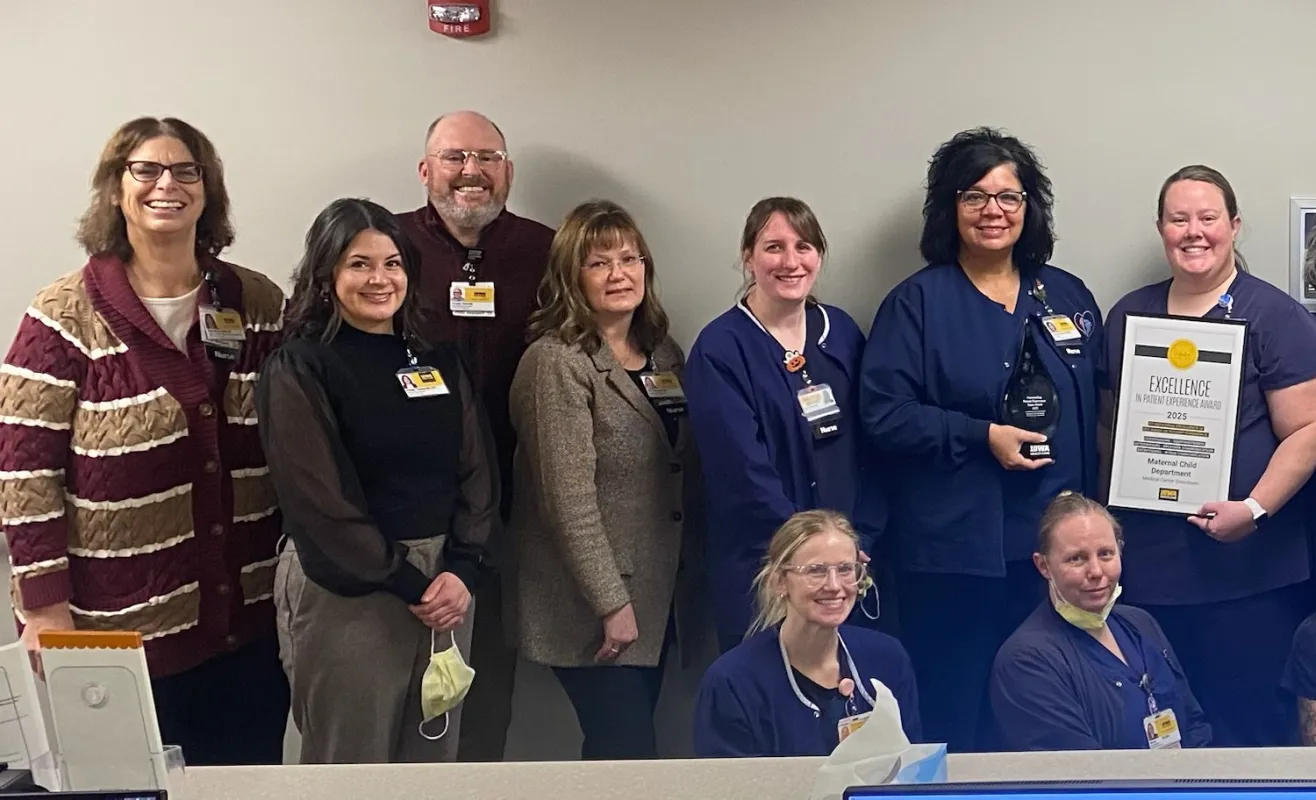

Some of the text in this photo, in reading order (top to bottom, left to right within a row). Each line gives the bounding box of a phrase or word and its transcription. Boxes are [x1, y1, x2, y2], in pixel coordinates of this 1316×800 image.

[443, 24, 470, 33] FIRE
[1149, 375, 1212, 398] EXCELLENCE
[1136, 393, 1222, 410] IN PATIENT EXPERIENCE AWARD
[1167, 411, 1188, 420] 2025
[1147, 458, 1197, 468] Maternal Child
[1151, 467, 1192, 477] Department
